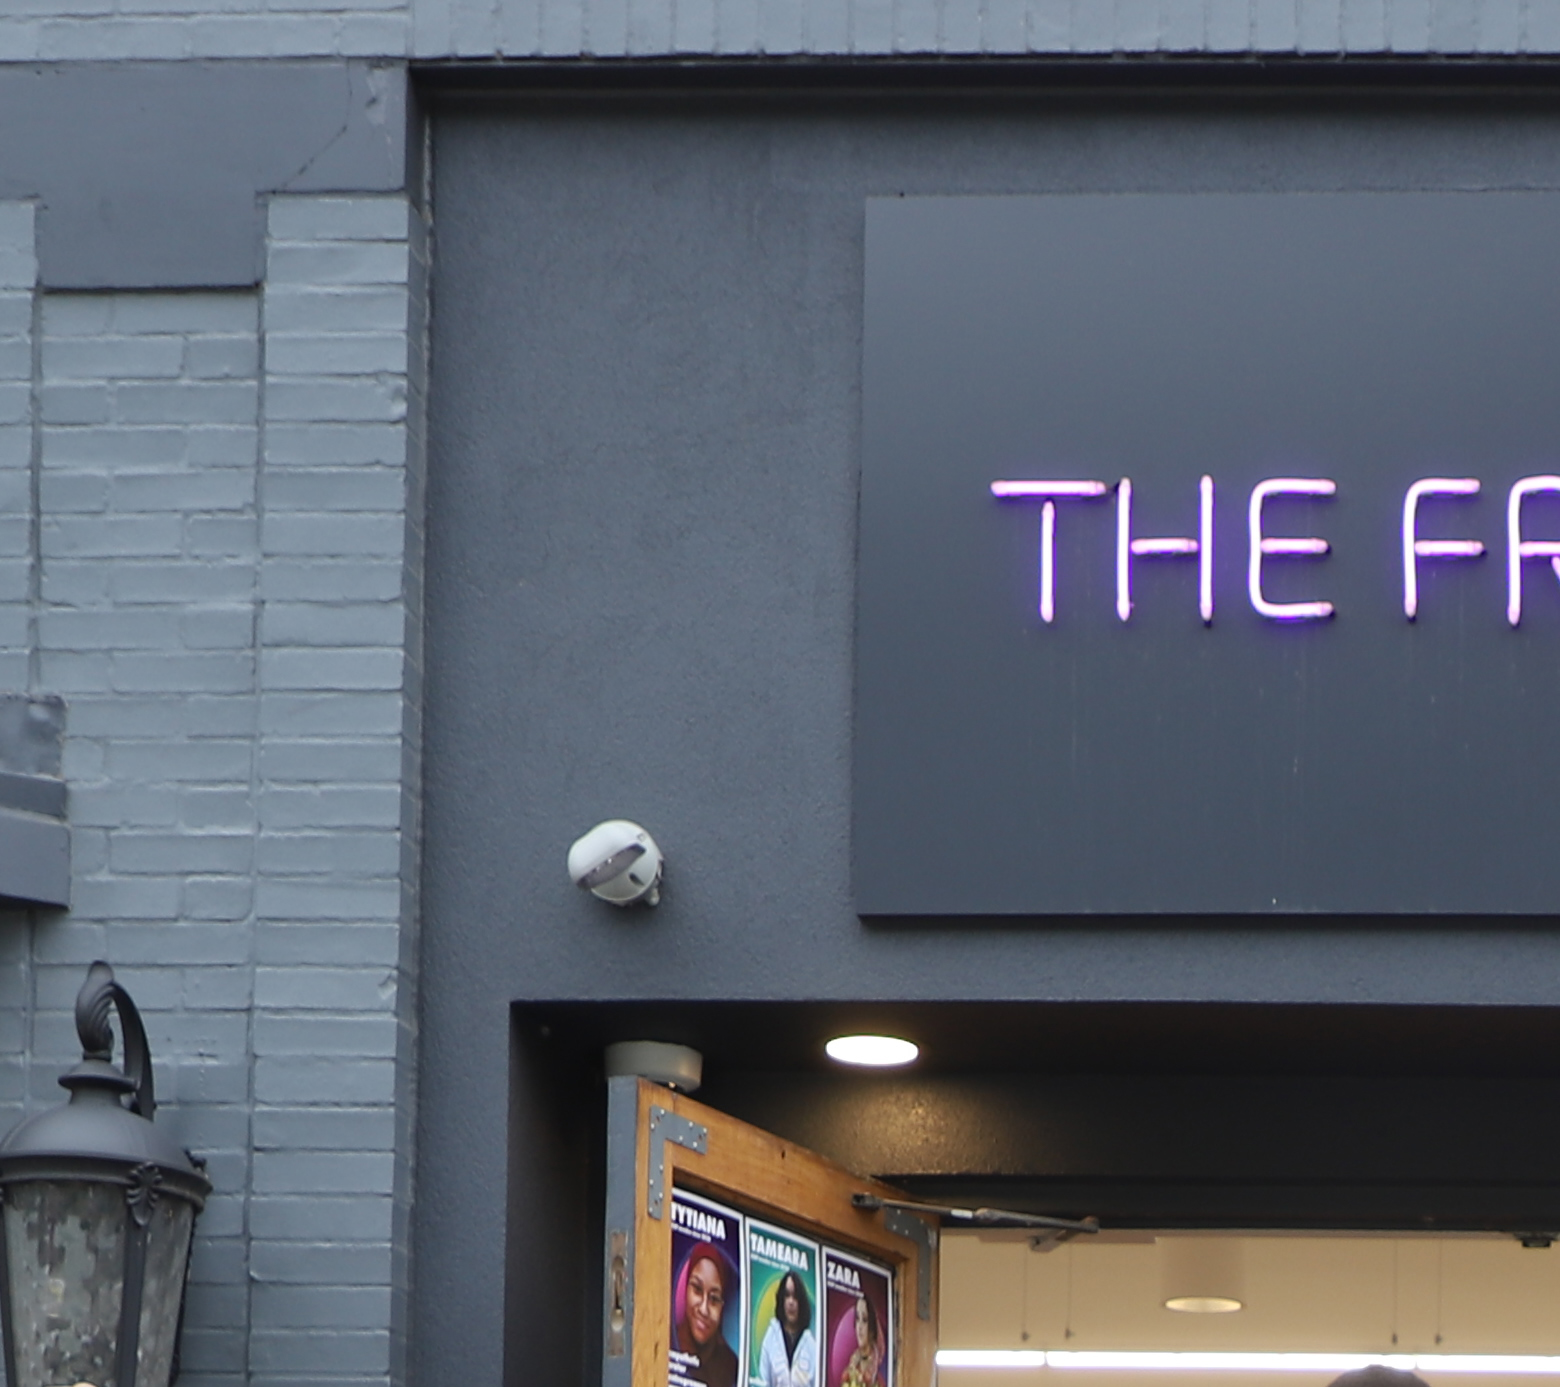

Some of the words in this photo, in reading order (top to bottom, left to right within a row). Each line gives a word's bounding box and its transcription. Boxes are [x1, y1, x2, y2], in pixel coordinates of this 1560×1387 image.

[989, 473, 1338, 624] THE
[671, 1201, 726, 1240] TYTIANA
[750, 1233, 809, 1272] TAMEARA
[827, 1261, 861, 1290] ZARA
